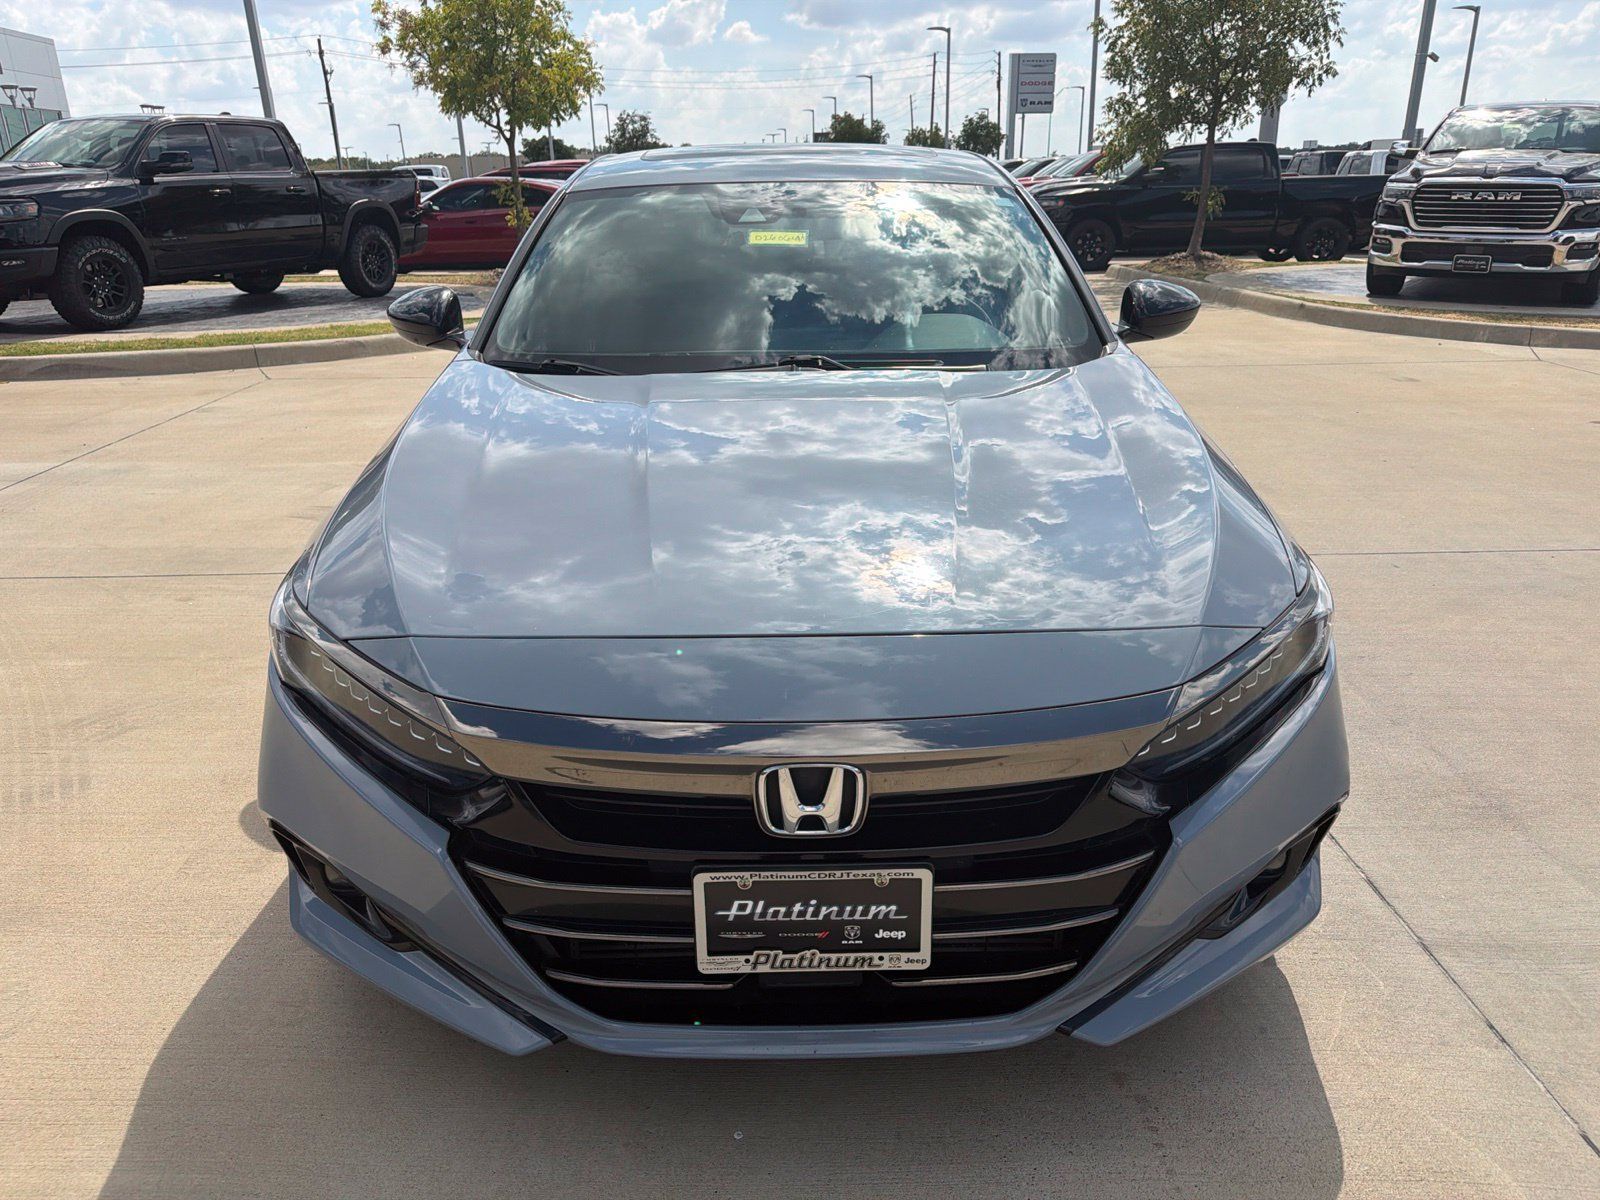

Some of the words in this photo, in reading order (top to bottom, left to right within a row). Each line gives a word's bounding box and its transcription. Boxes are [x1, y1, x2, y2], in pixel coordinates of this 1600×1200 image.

[1451, 192, 1522, 200] RAM
[715, 900, 908, 921] Platinum
[874, 929, 907, 940] Jeep
[751, 950, 884, 971] Platinum
[904, 957, 927, 965] Jeep
